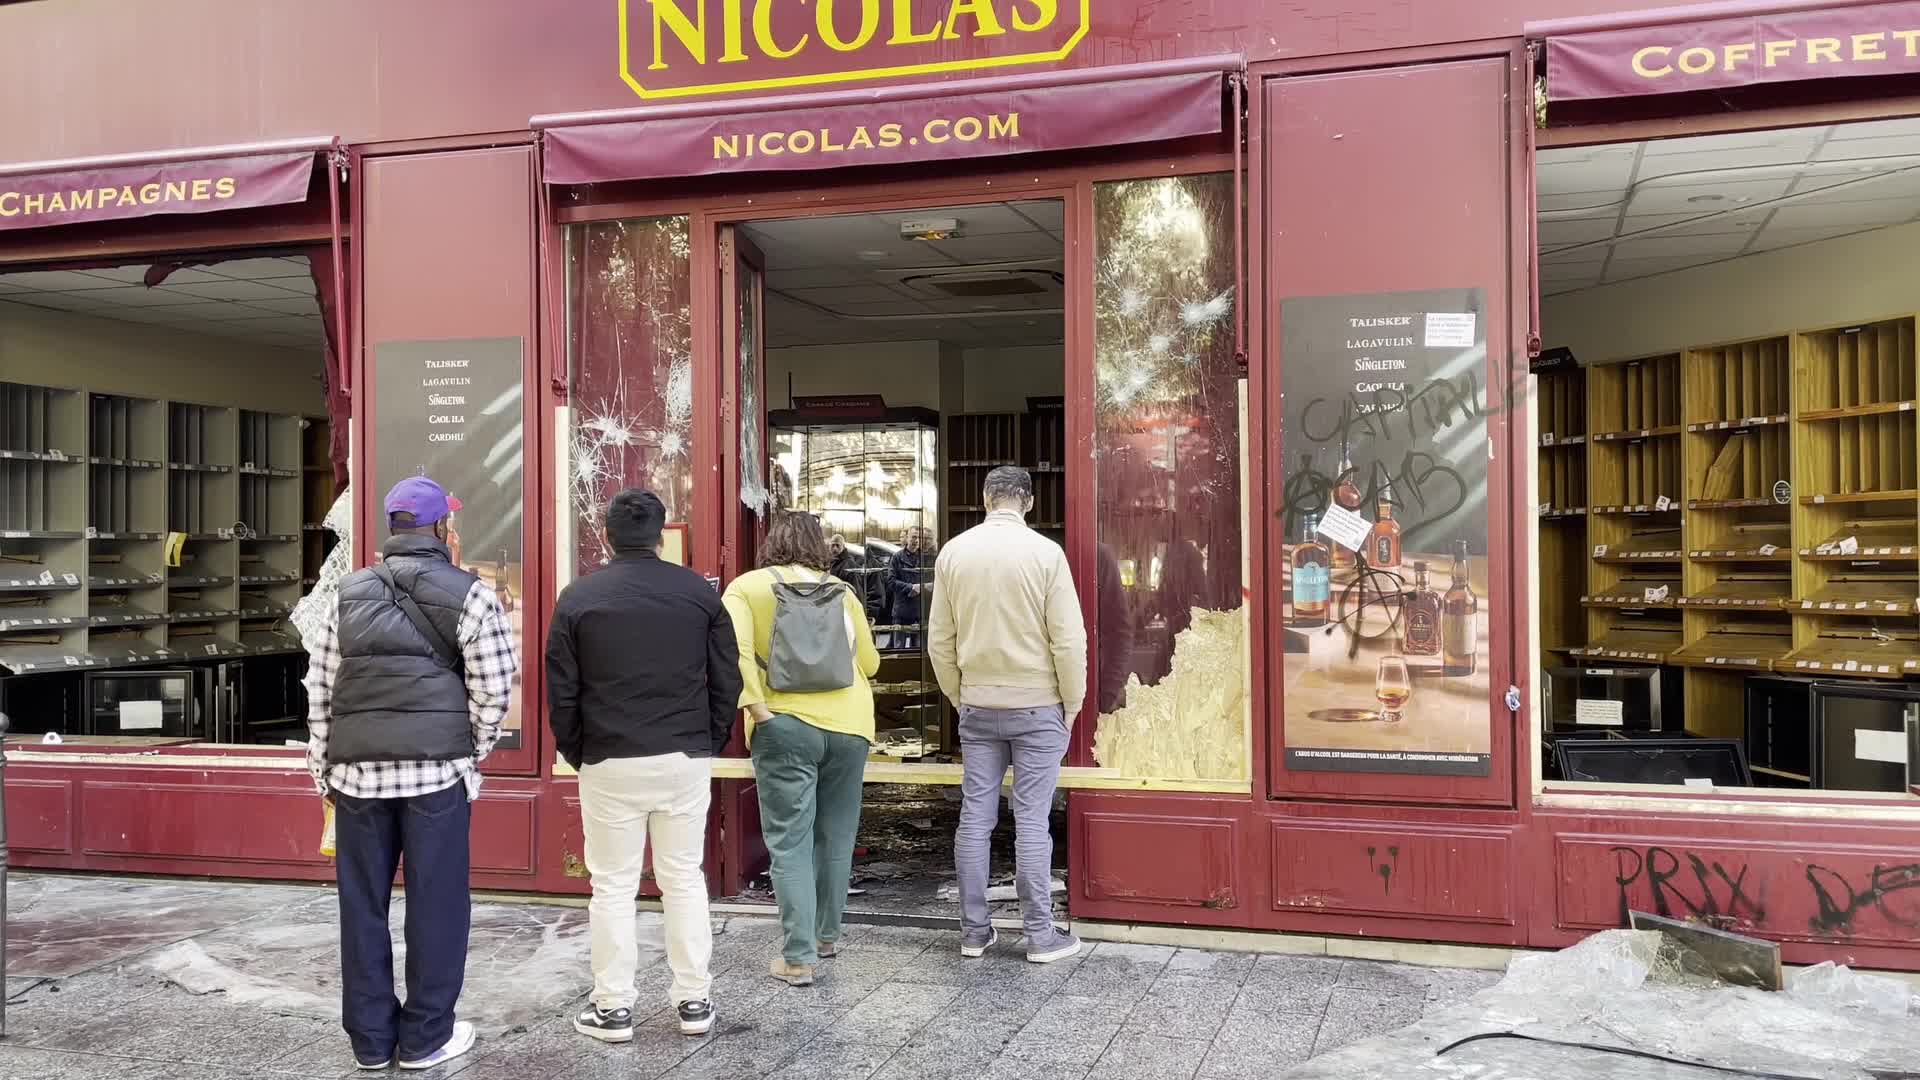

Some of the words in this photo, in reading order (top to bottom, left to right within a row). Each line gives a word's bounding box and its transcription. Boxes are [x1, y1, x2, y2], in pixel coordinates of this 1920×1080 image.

[1632, 30, 1920, 77] COFFRET
[713, 113, 1020, 158] NICOLAS.COM
[0, 177, 236, 216] CHAMPAGNES
[1350, 317, 1411, 327] TALISKER
[425, 360, 470, 368] TALISKER
[423, 377, 471, 386] LAGAVULIN
[429, 415, 450, 423] CAOL
[452, 415, 464, 423] ILA
[429, 433, 464, 441] CARDHU
[1610, 846, 1766, 929] PRIX
